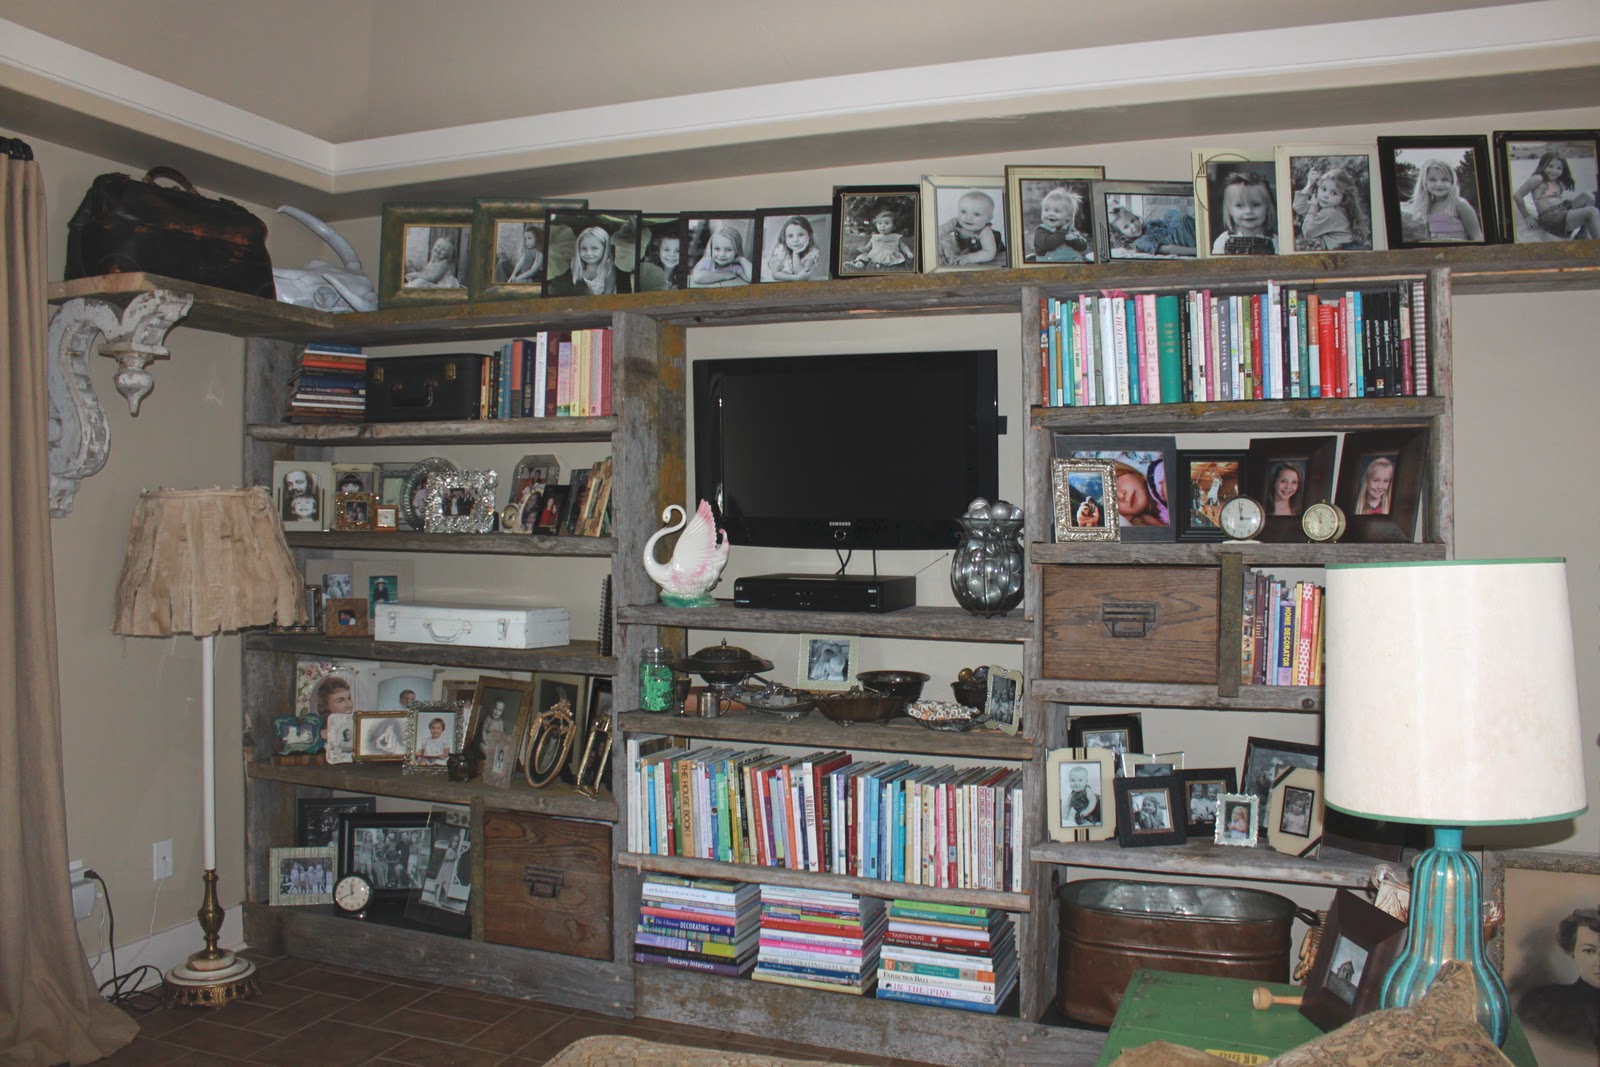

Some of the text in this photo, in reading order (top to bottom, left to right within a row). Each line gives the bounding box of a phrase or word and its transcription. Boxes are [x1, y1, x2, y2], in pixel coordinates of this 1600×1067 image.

[1282, 607, 1292, 667] HOME DECORATOR
[681, 764, 692, 833] THE HOUSE BOOK
[680, 921, 710, 933] DECORATING
[667, 956, 714, 970] Tuscany Interiors
[894, 982, 953, 998] IN THE PINK
